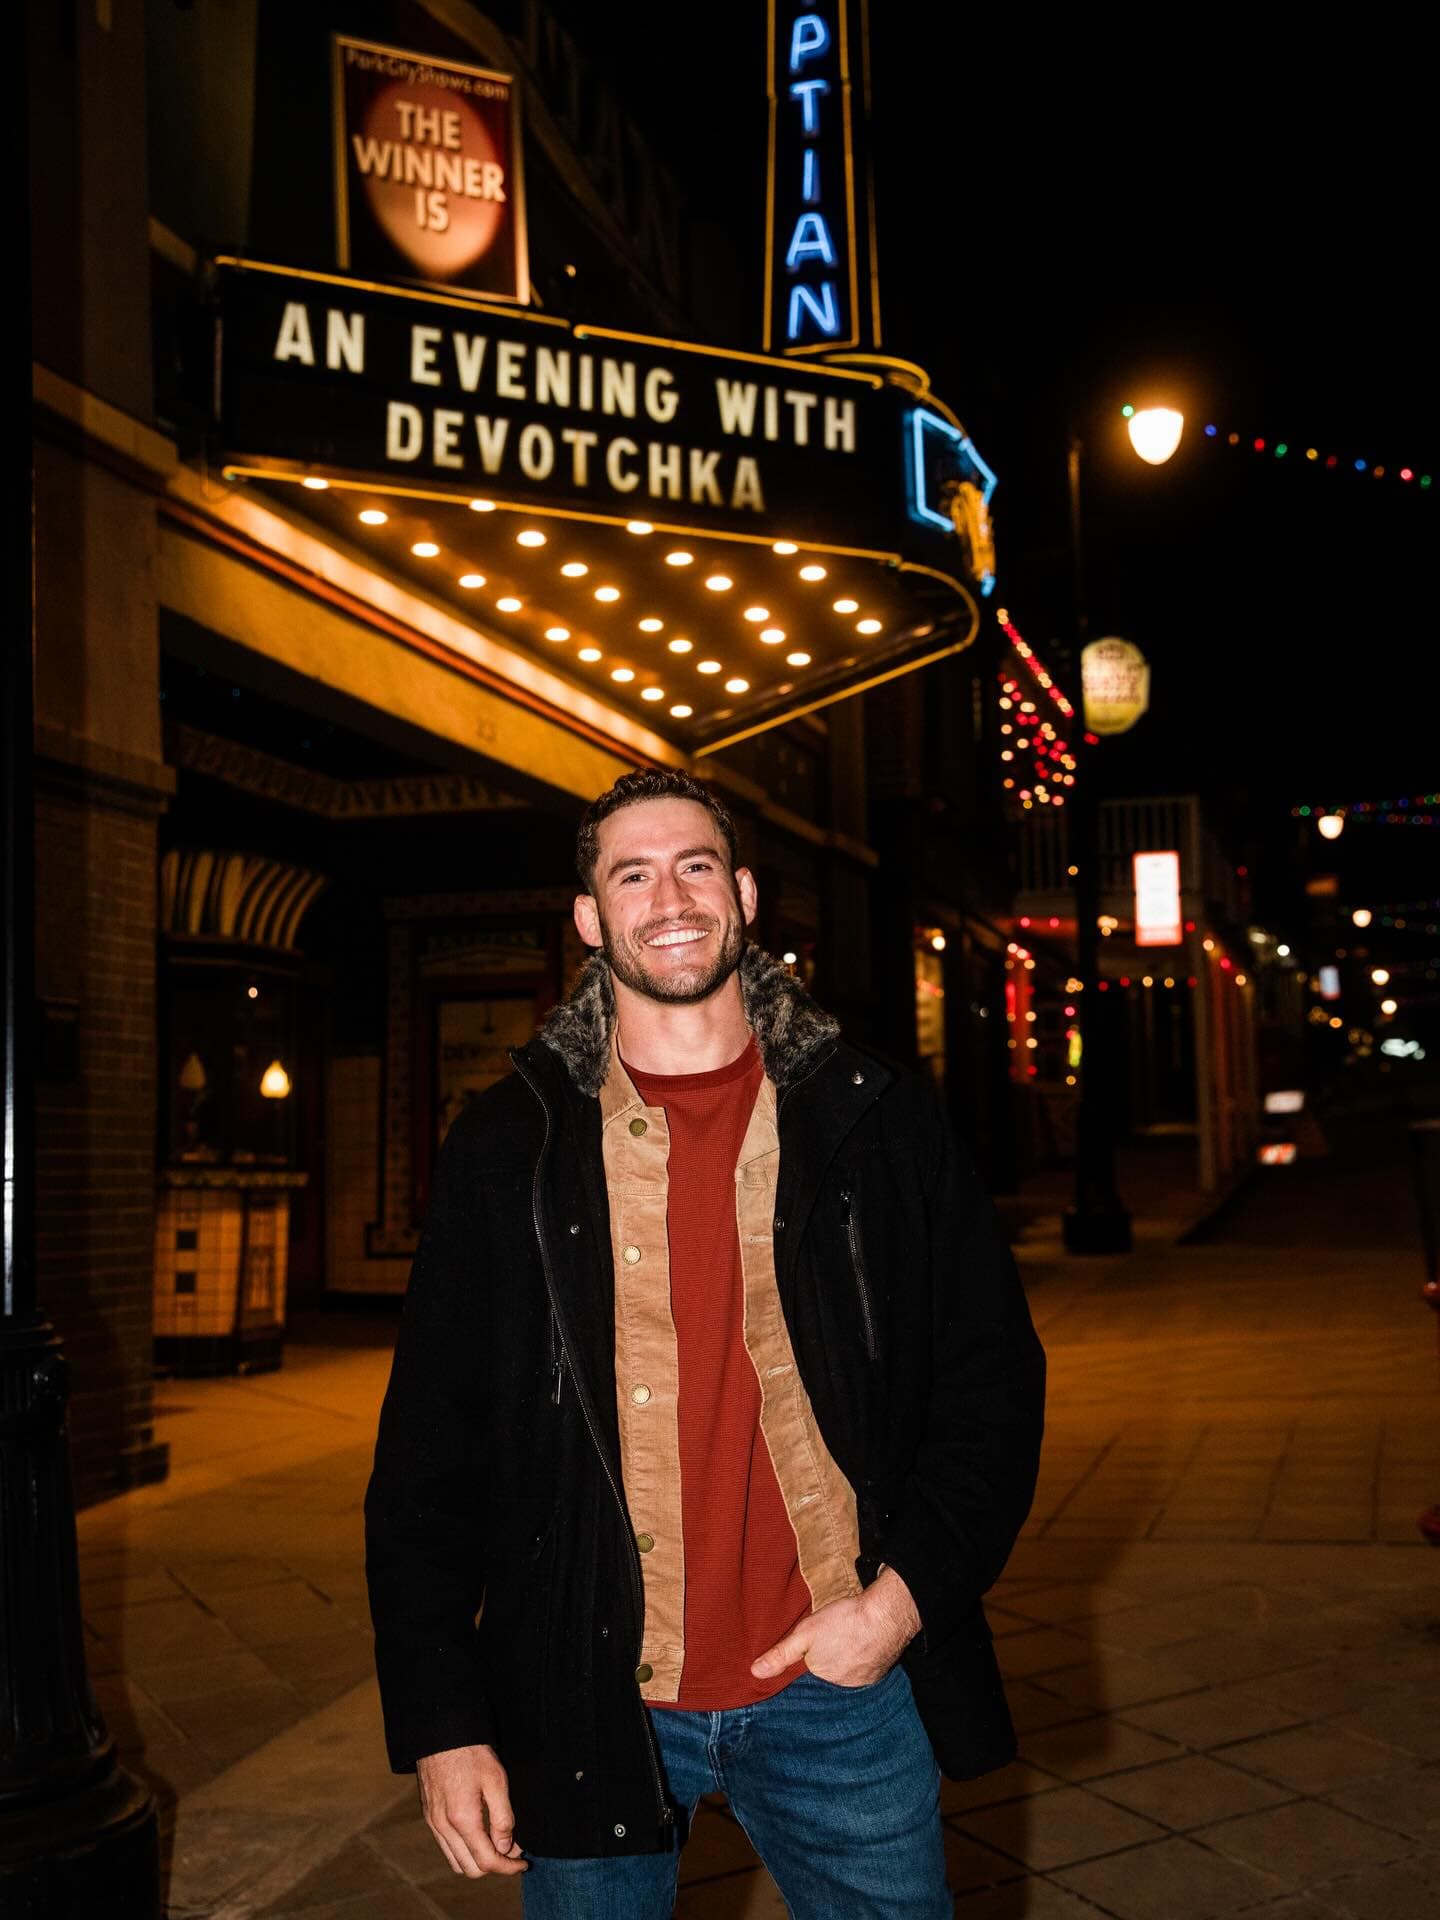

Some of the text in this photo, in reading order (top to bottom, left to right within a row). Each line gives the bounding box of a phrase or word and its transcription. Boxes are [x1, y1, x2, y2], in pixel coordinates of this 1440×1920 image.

[346, 49, 509, 101] ParkCityShows.com
[397, 101, 460, 149] THE
[353, 134, 507, 202] WINNER
[787, 0, 838, 340] PTIAN
[416, 190, 449, 232] IS
[274, 302, 857, 452] AN EVENING WITH
[385, 402, 765, 512] DEVOTCHKA
